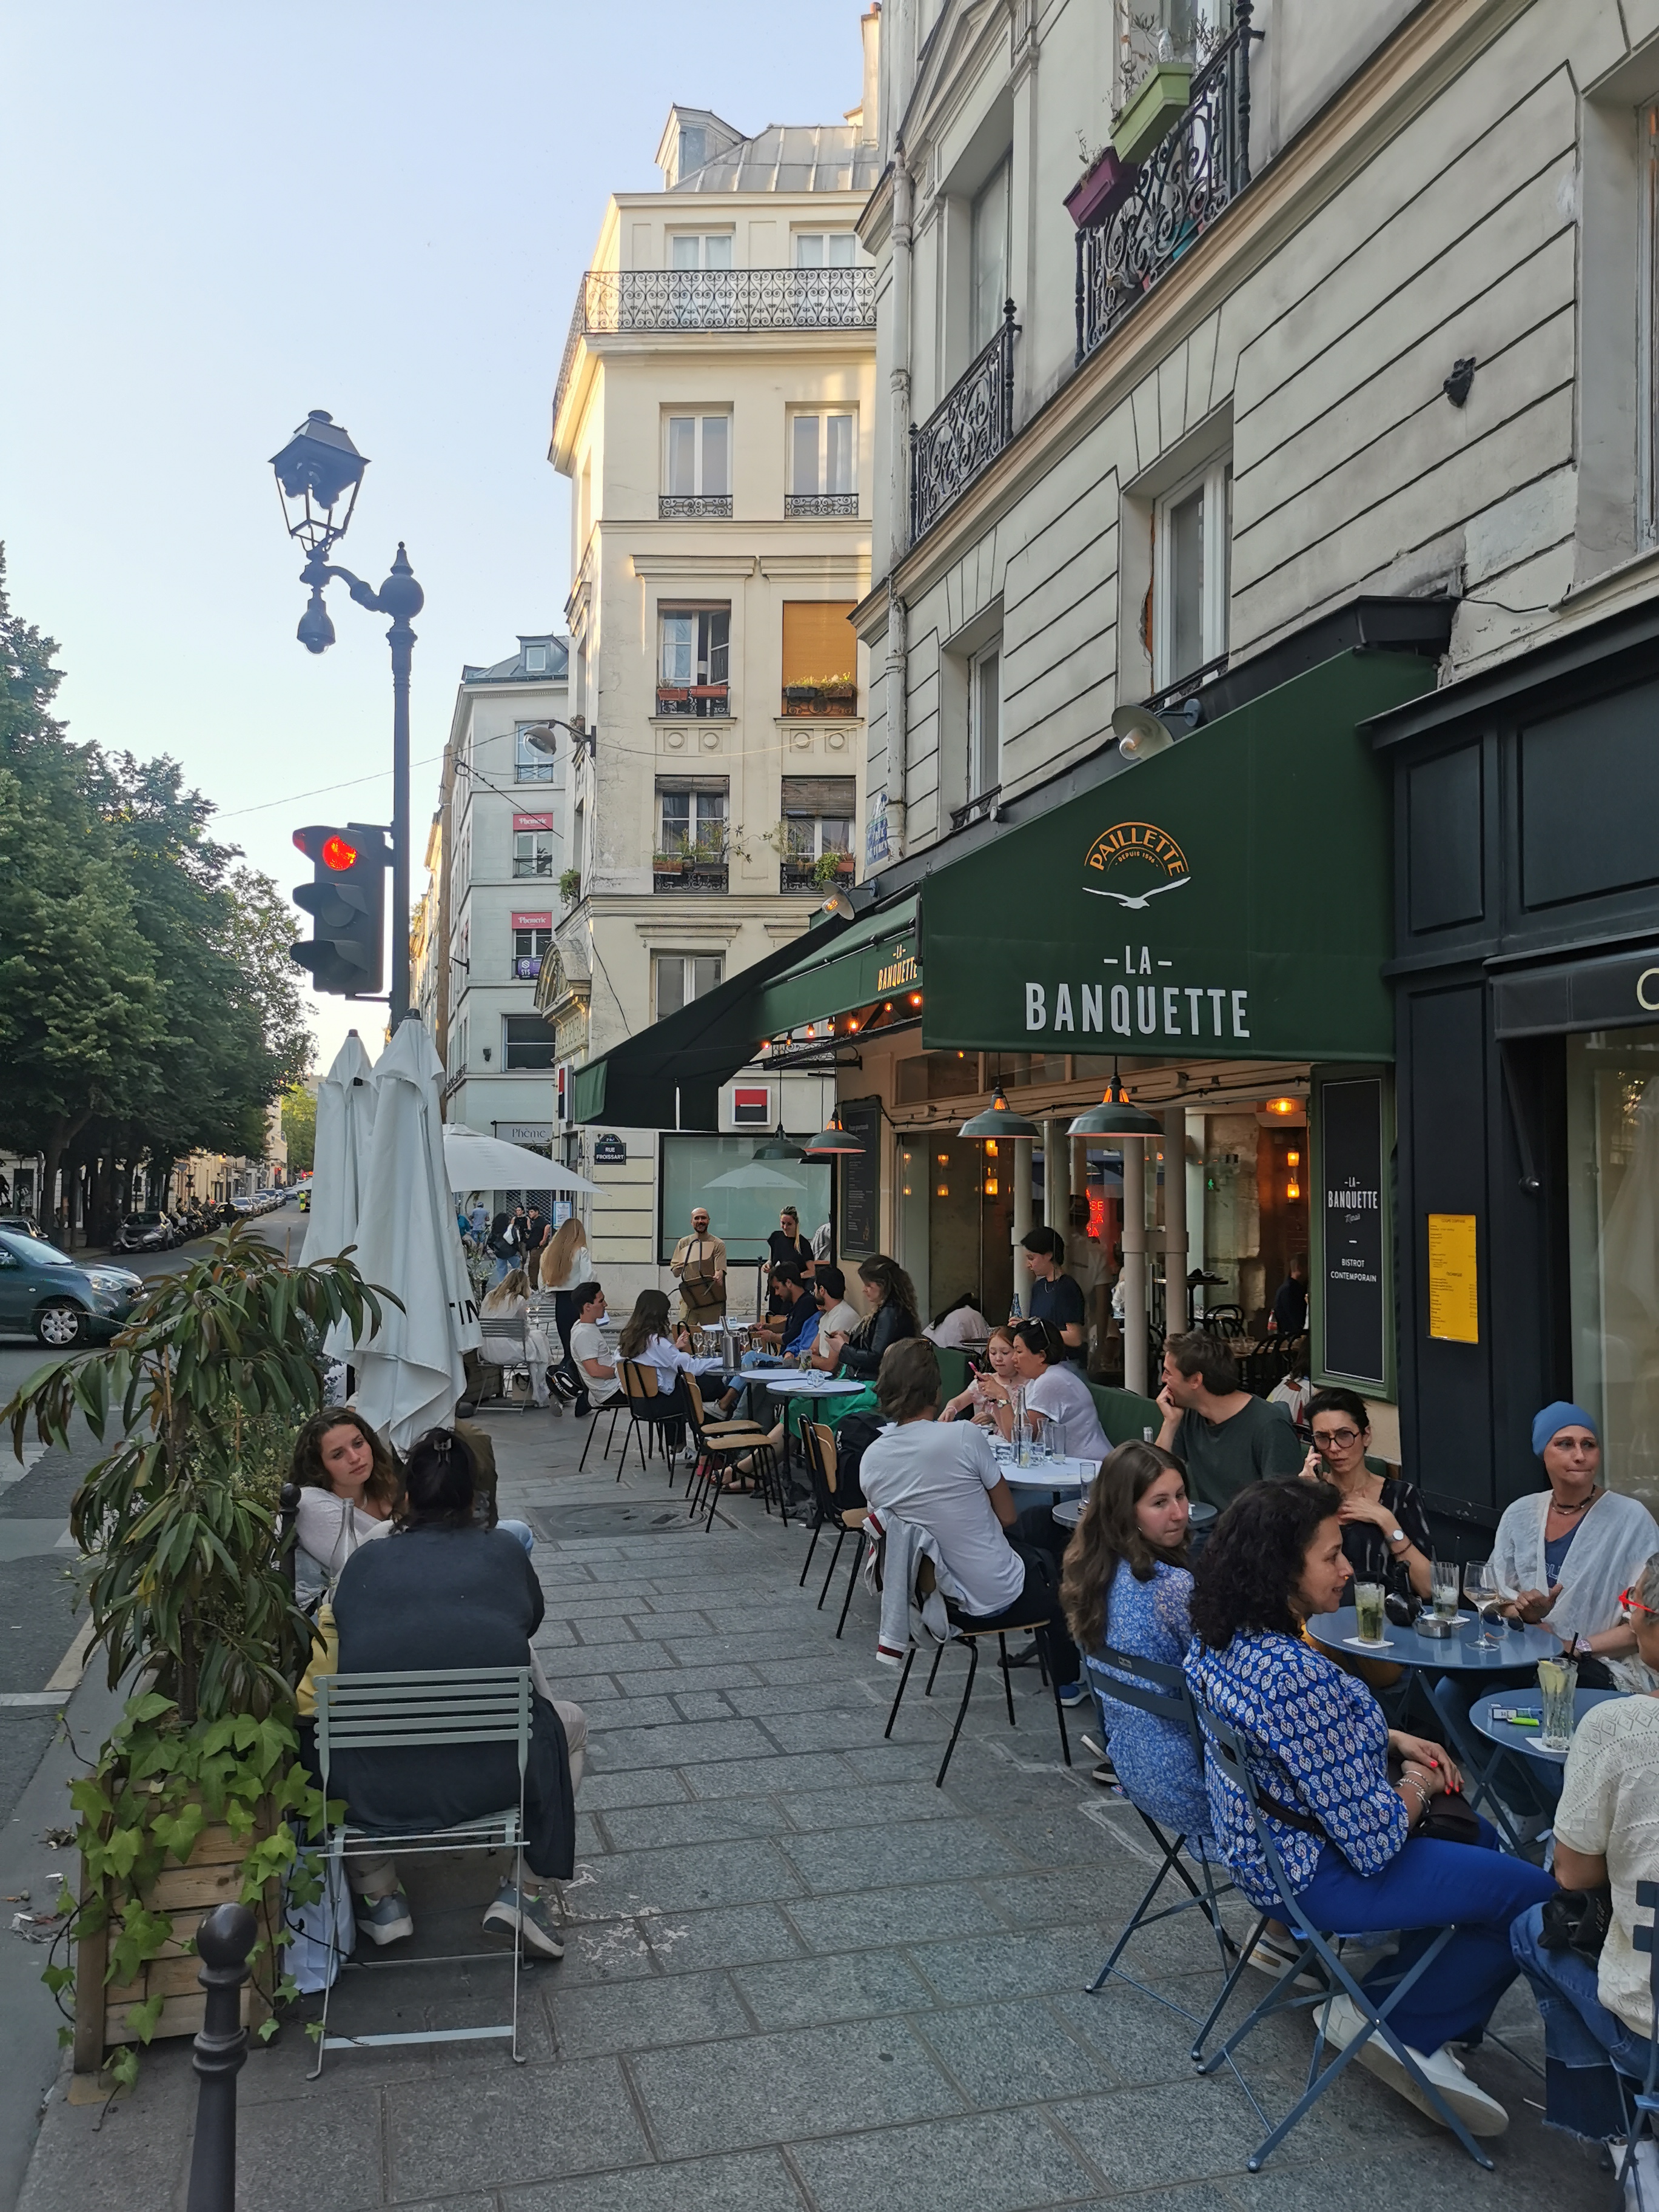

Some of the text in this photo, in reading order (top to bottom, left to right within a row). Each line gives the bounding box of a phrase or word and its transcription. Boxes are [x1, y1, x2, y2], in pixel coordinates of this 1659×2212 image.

[1089, 827, 1185, 877] PAILLETTE
[1118, 851, 1141, 862] DEPUIS
[877, 956, 917, 992] BANQUETTE
[1025, 982, 1251, 1038] BANQUETTE
[1328, 1190, 1378, 1209] BANQUETTE
[1341, 1258, 1365, 1267] BISTROT
[1330, 1271, 1377, 1282] CONTEMPORAIN
